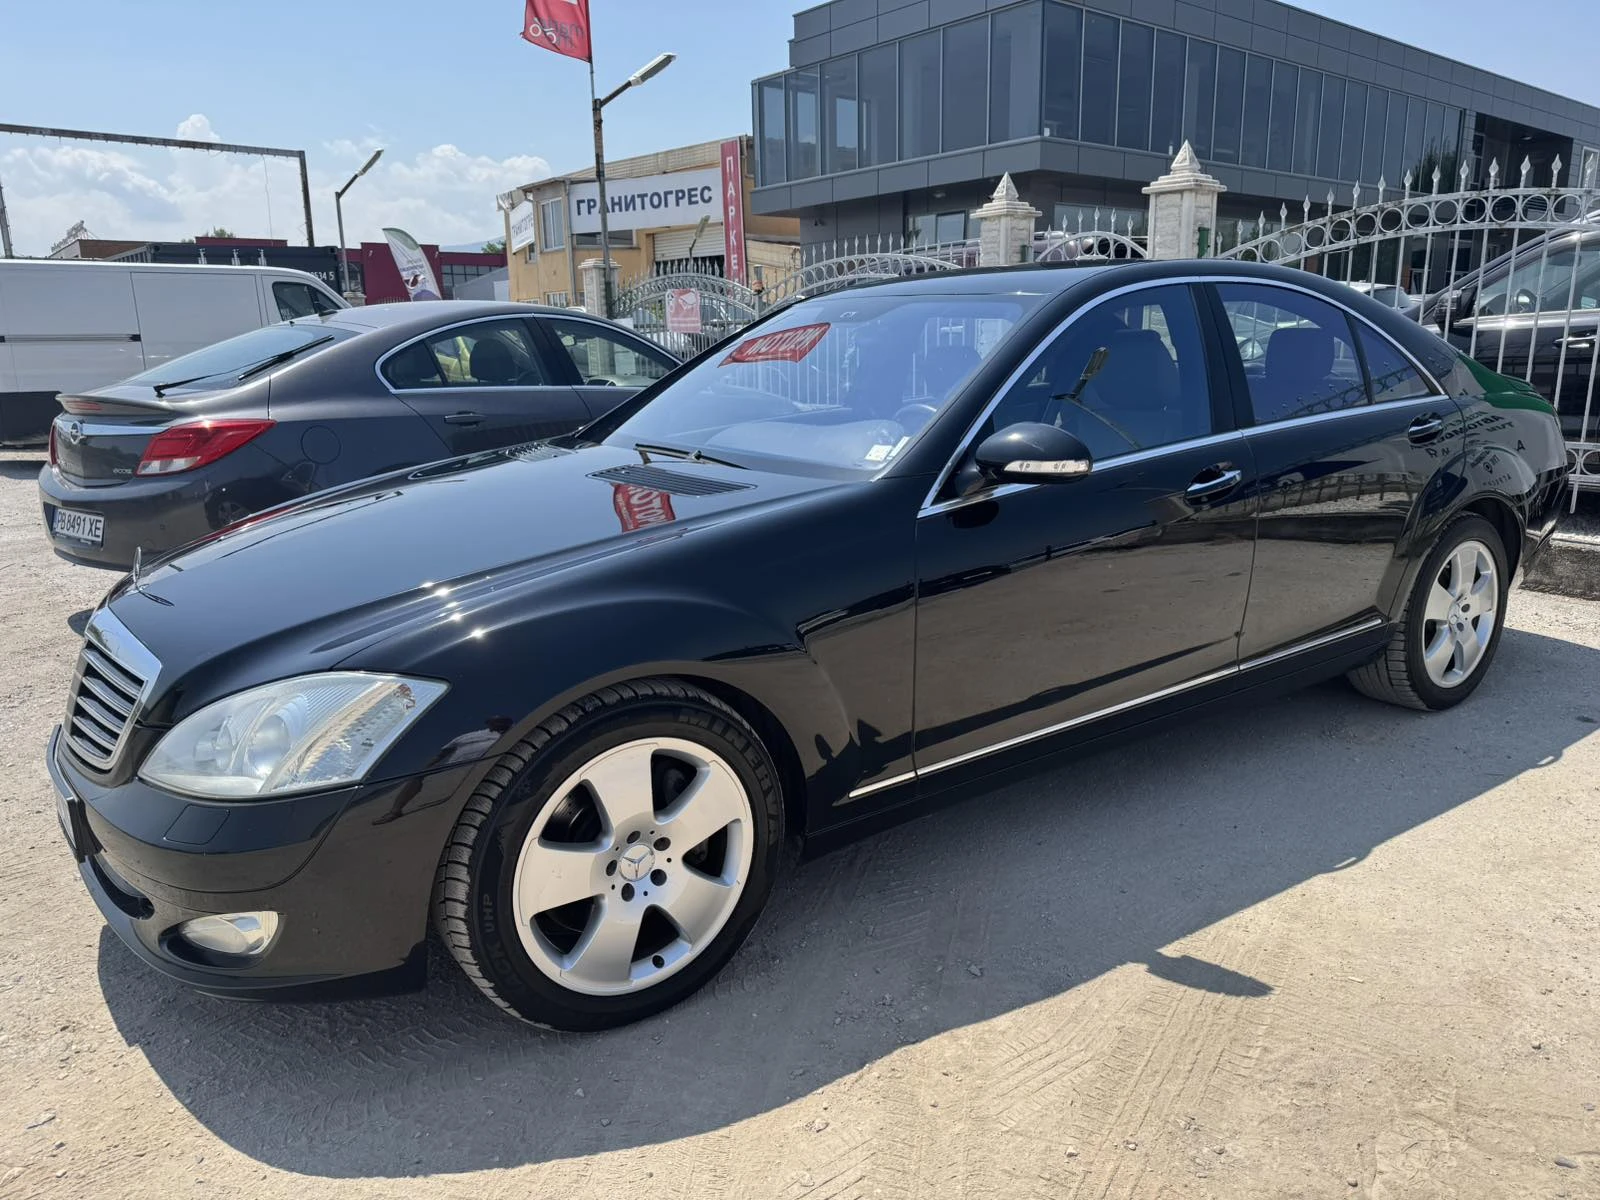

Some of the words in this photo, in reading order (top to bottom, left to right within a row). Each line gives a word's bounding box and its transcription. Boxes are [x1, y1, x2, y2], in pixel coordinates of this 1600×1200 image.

[725, 156, 740, 290] ПАРКЕ
[66, 514, 86, 536] 8491
[87, 517, 102, 538] XE
[672, 707, 779, 847] MINERVA
[483, 893, 496, 933] UHP
